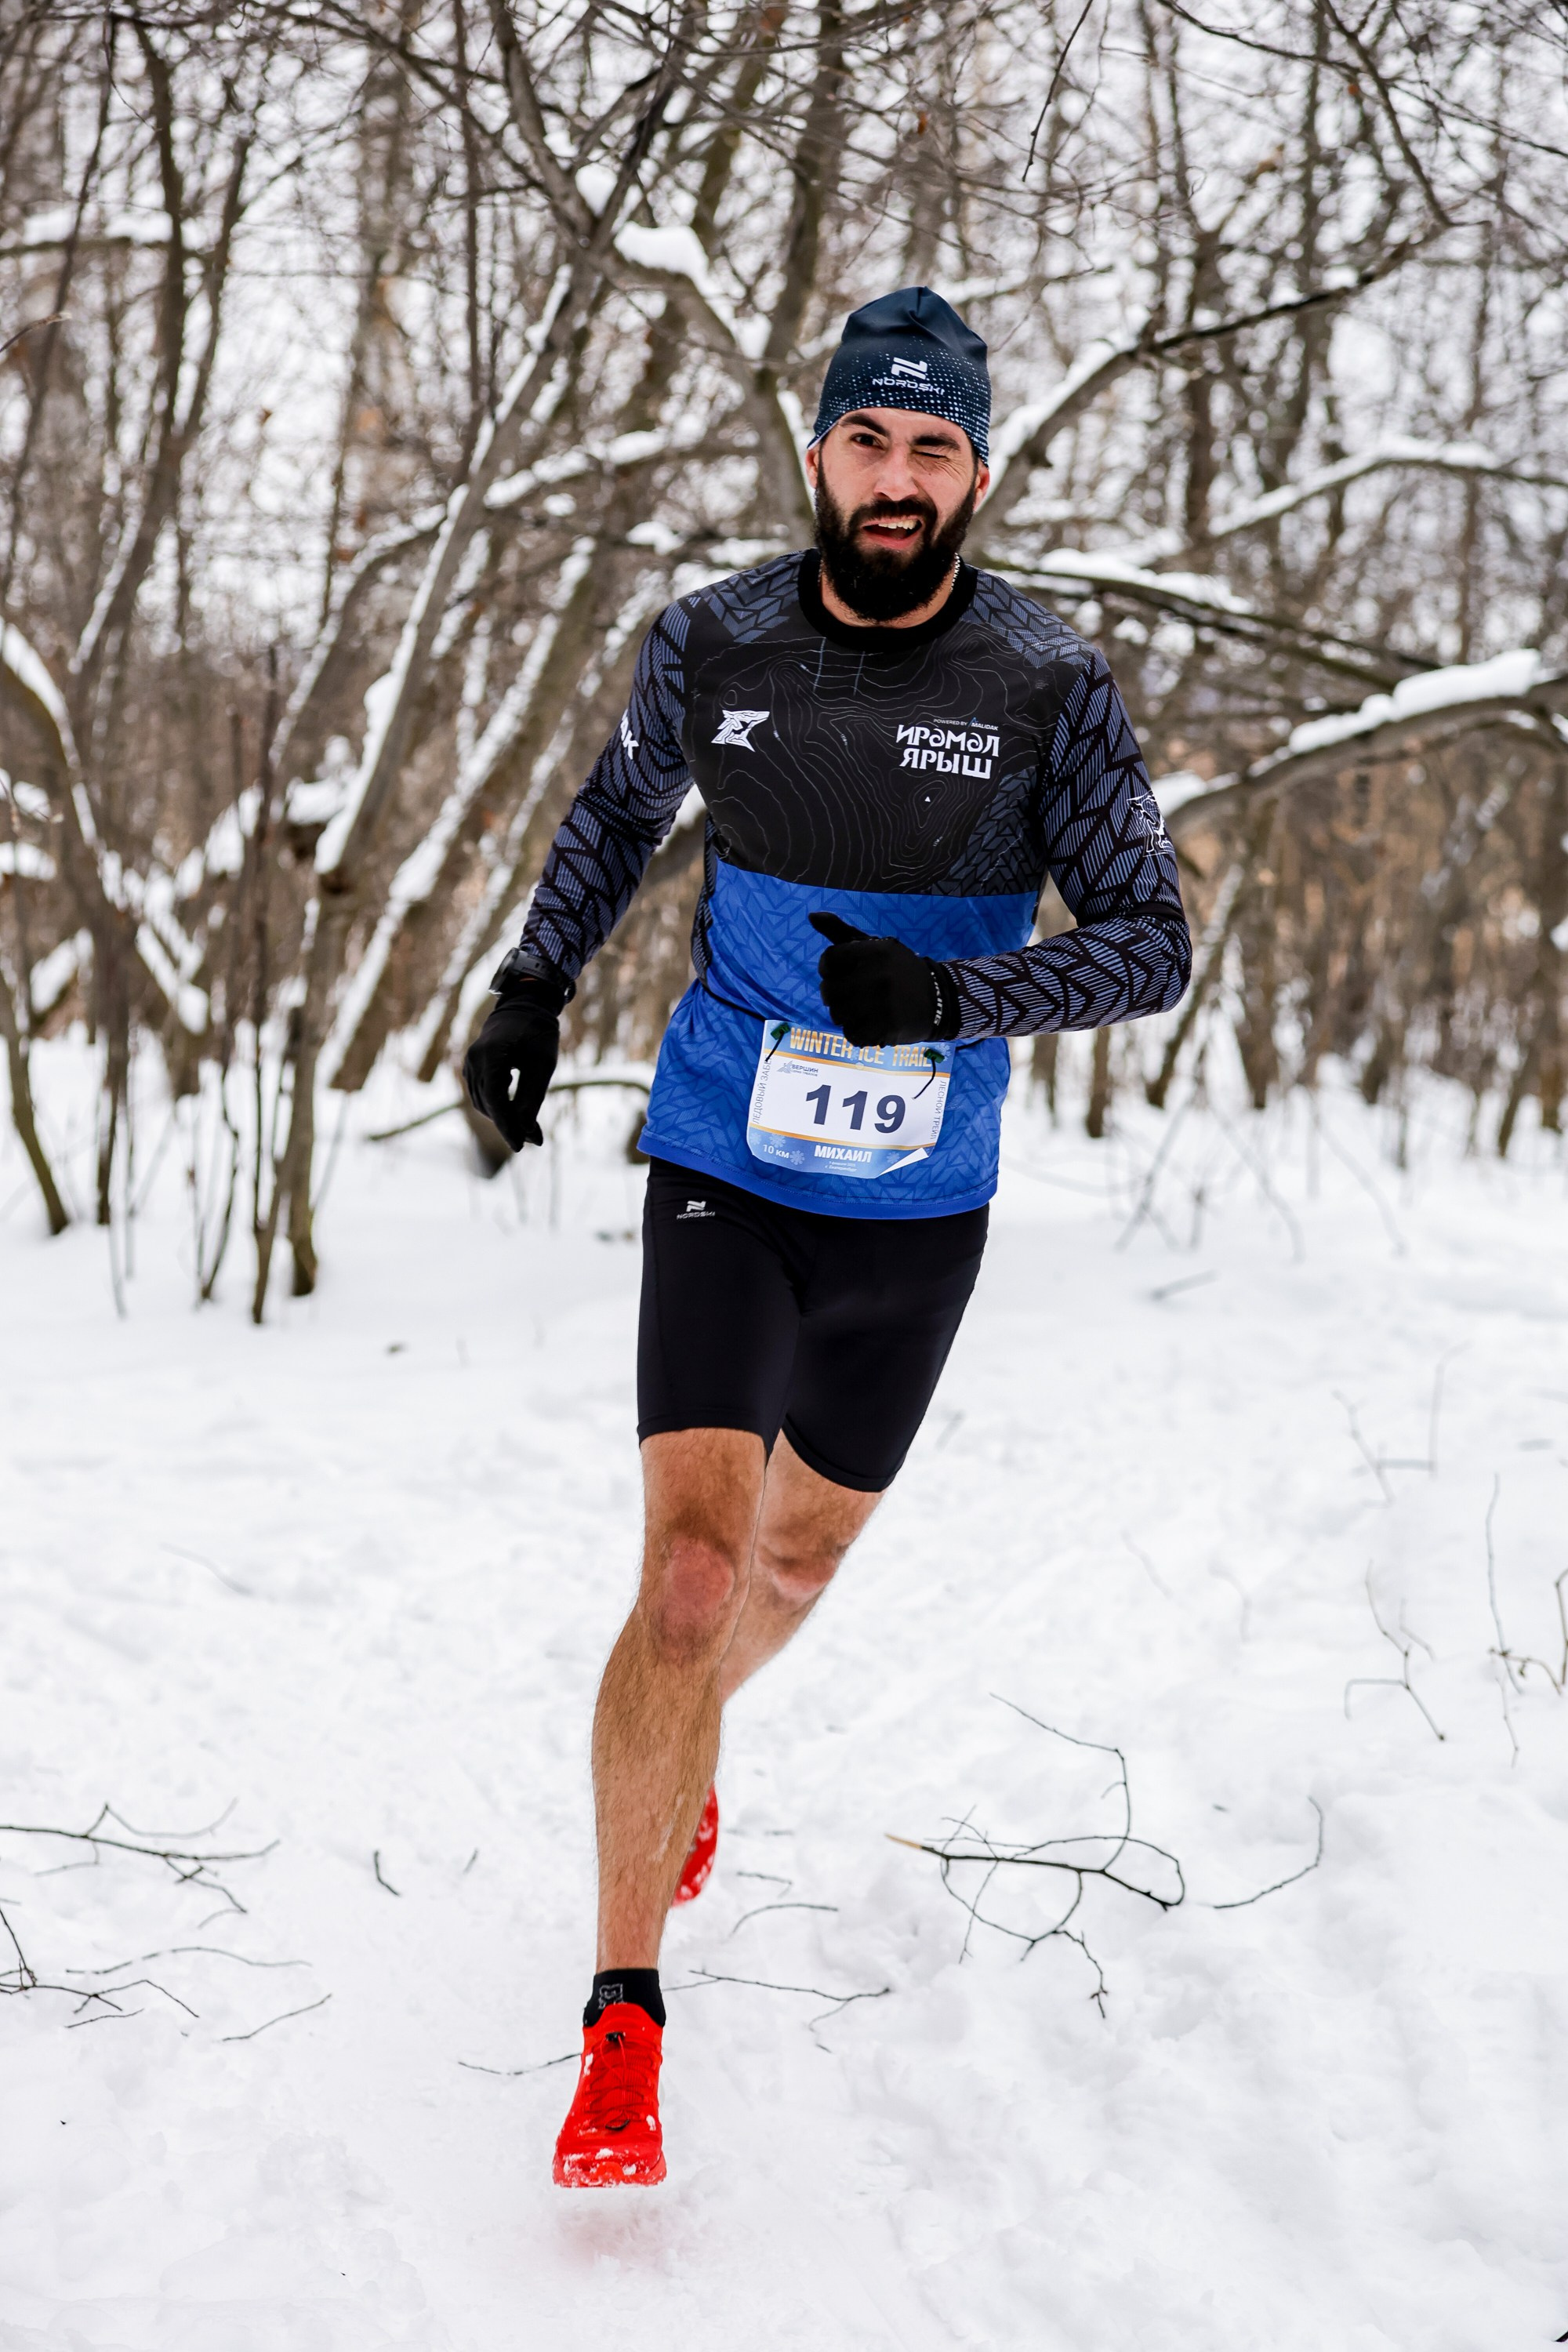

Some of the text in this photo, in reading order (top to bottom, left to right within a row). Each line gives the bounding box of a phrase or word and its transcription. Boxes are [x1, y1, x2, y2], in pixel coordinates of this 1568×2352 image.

[872, 376, 945, 396] NORDSKI
[971, 722, 999, 731] MALIDAK
[899, 748, 992, 779] ЯРЫШ
[790, 1027, 931, 1068] WINTER ICE TRAIL
[753, 1083, 767, 1124] ЛЕДОВЫЙ
[805, 1084, 906, 1134] 119
[935, 1080, 946, 1114] ЛЕСНОЙ
[763, 1144, 775, 1154] 10
[814, 1145, 873, 1163] МИХАИЛ
